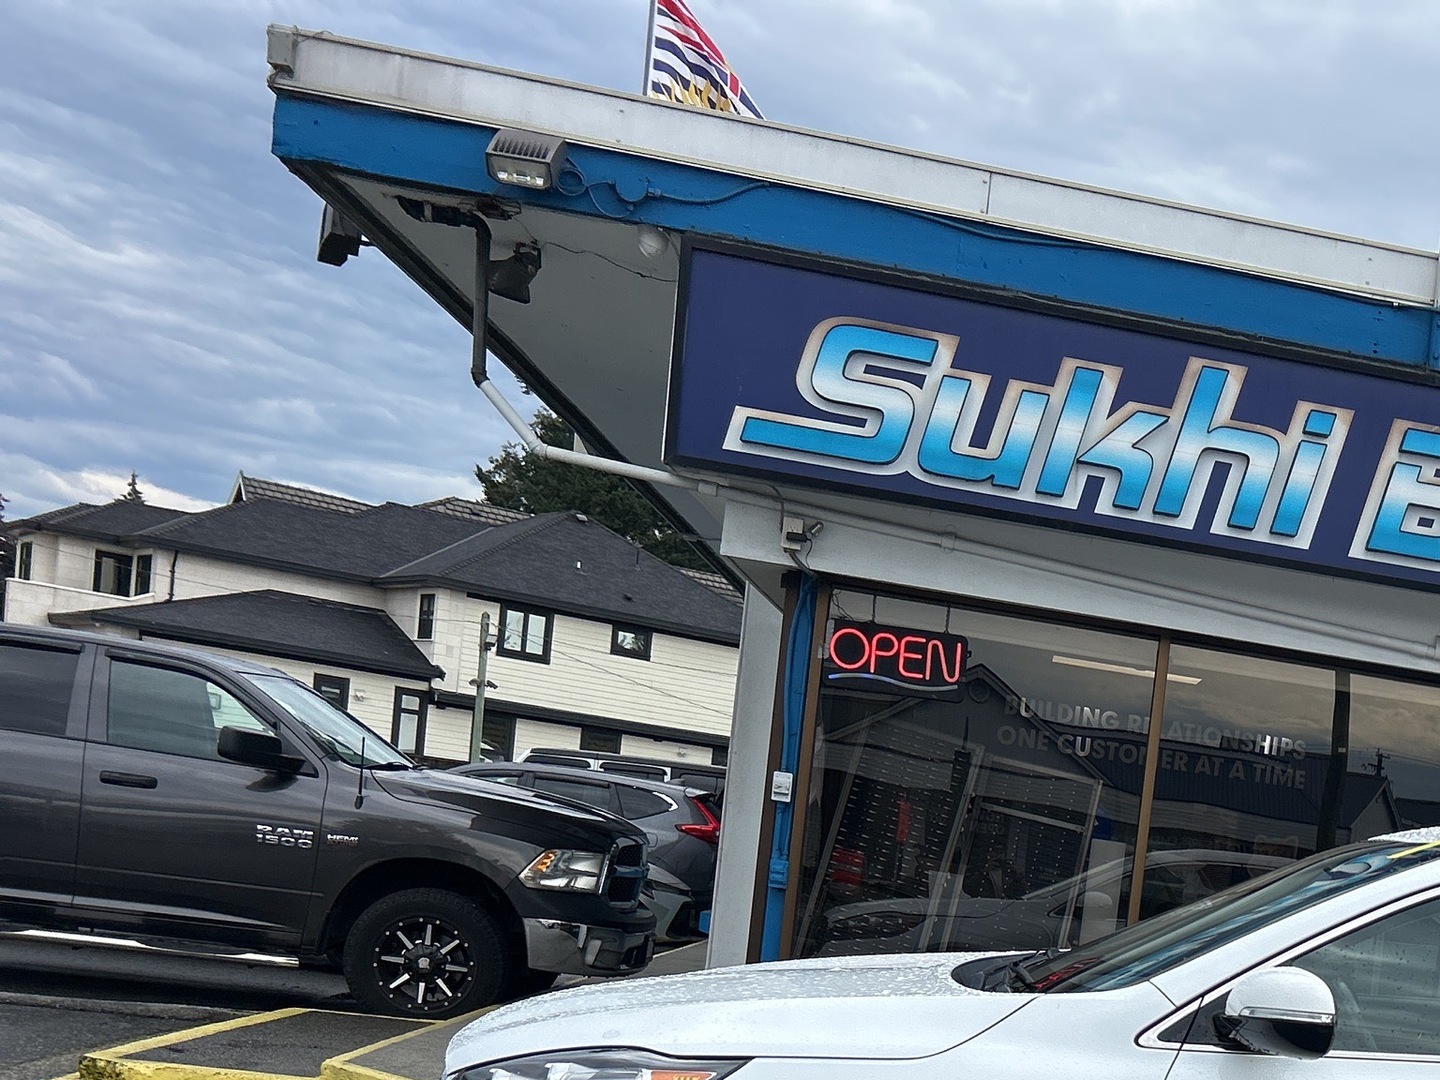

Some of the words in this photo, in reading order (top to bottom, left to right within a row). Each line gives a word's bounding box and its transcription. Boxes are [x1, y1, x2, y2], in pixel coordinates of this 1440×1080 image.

[722, 315, 1355, 550] Sukhi
[829, 627, 963, 683] OPEN
[997, 725, 1050, 751] ONE
[1058, 734, 1188, 772] CUSTOER
[1195, 755, 1225, 776] AT
[1229, 761, 1246, 781] A
[1253, 763, 1306, 790] TIME
[1004, 695, 1121, 730] BUILDING
[1127, 714, 1307, 760] RATIONSHIPS
[256, 824, 314, 840] RAM
[256, 833, 313, 849] 1500
